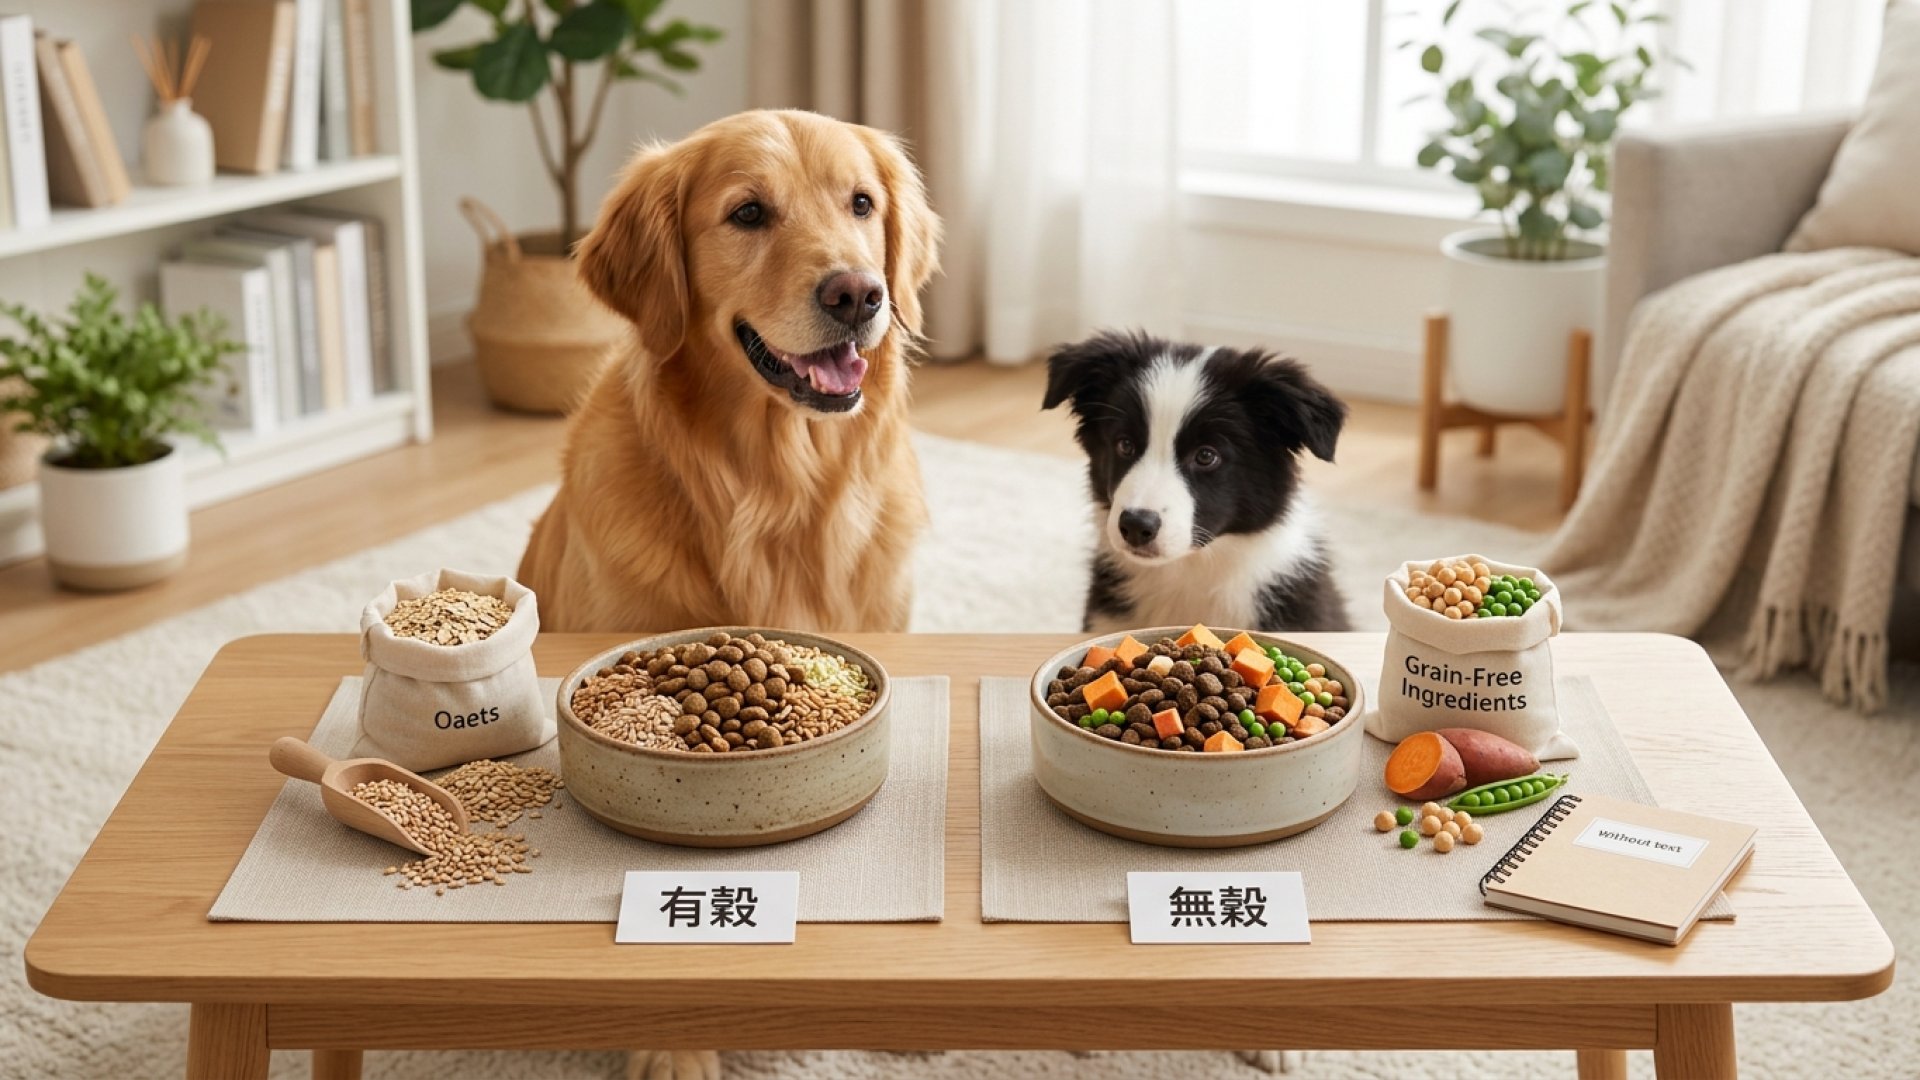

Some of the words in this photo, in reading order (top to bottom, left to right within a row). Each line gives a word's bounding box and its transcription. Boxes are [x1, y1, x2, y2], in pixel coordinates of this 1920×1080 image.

[1405, 655, 1523, 687] Grain-Free
[1402, 677, 1527, 712] Ingredients
[434, 706, 500, 730] Oaets
[659, 886, 758, 928] 有穀
[1169, 886, 1268, 928] 無穀
